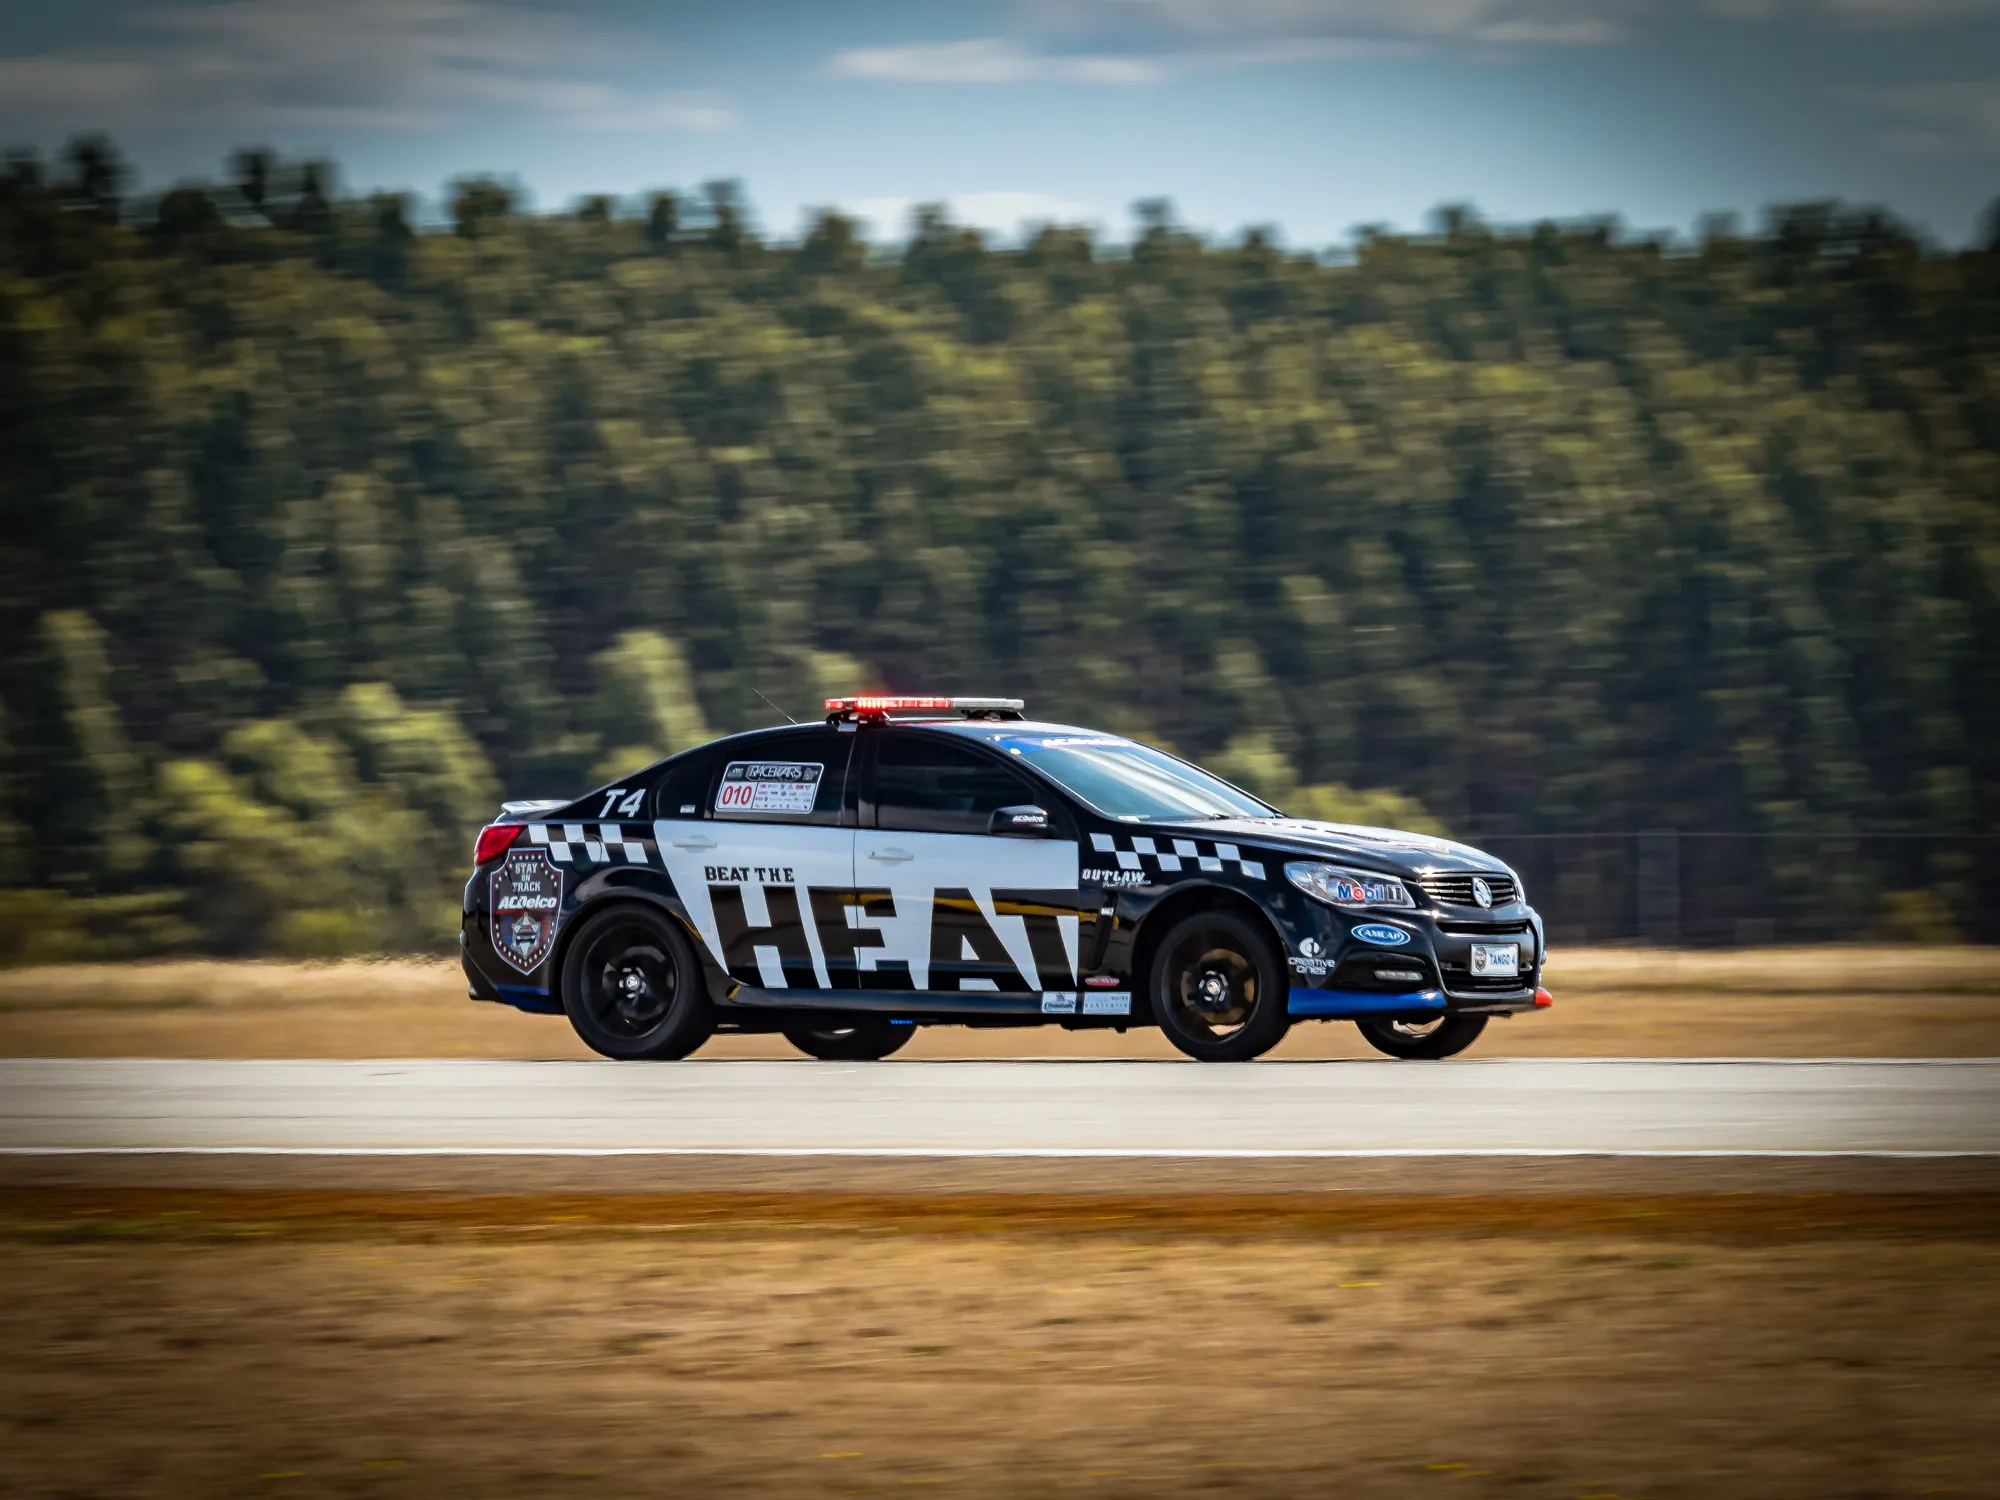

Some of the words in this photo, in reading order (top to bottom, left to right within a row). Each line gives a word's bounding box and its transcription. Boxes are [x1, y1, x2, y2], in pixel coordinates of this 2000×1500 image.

[598, 788, 647, 818] T4
[721, 785, 753, 805] 010
[515, 862, 538, 874] STAY
[704, 866, 749, 882] BEAT
[754, 867, 795, 883] THE
[1082, 868, 1146, 882] OUTLAW
[512, 881, 541, 892] TRACK
[1337, 883, 1385, 901] Mobil
[498, 894, 557, 910] ACDelco
[707, 884, 1079, 991] HEAT
